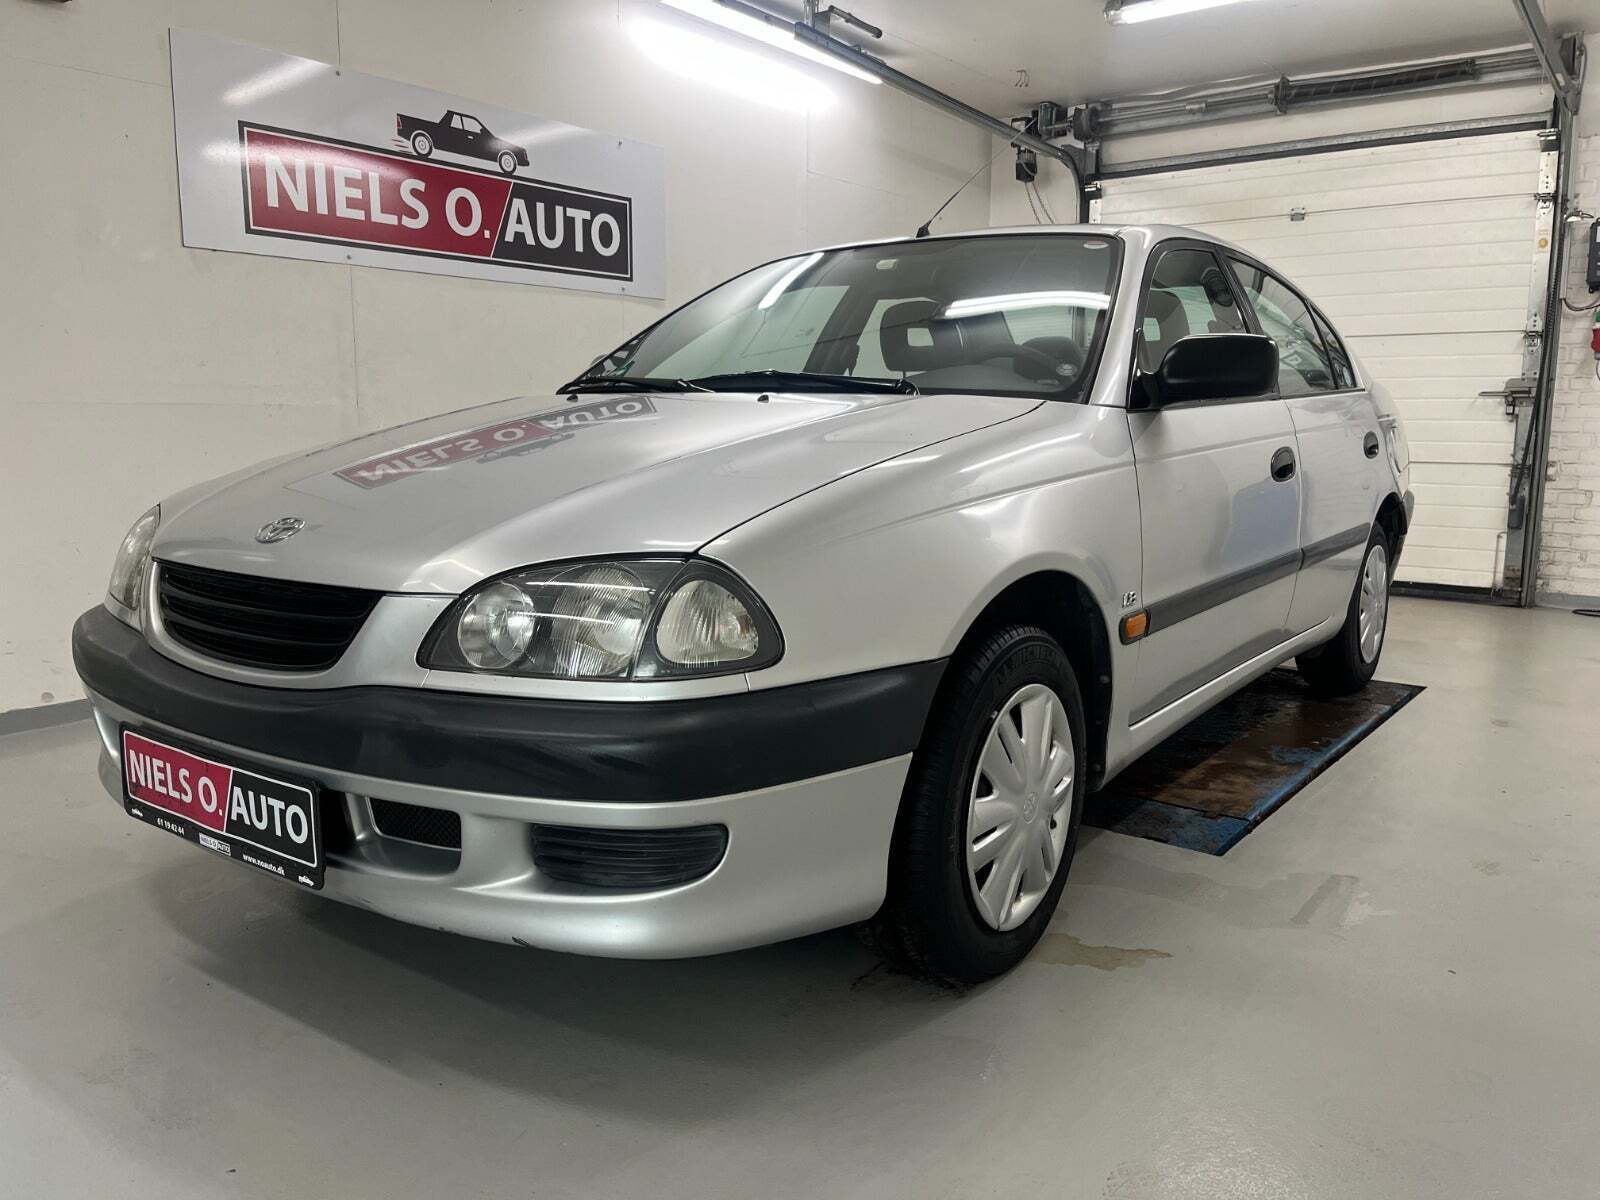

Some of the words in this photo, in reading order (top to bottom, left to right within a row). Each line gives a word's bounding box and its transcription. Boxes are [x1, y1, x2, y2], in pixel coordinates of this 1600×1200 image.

[264, 153, 429, 230] NIELS
[445, 187, 491, 239] O.
[504, 198, 621, 257] AUTO
[129, 749, 193, 804] NIELS
[198, 776, 223, 817] O.
[230, 786, 309, 844] AUTO
[242, 853, 285, 876] www.noauto.dk
